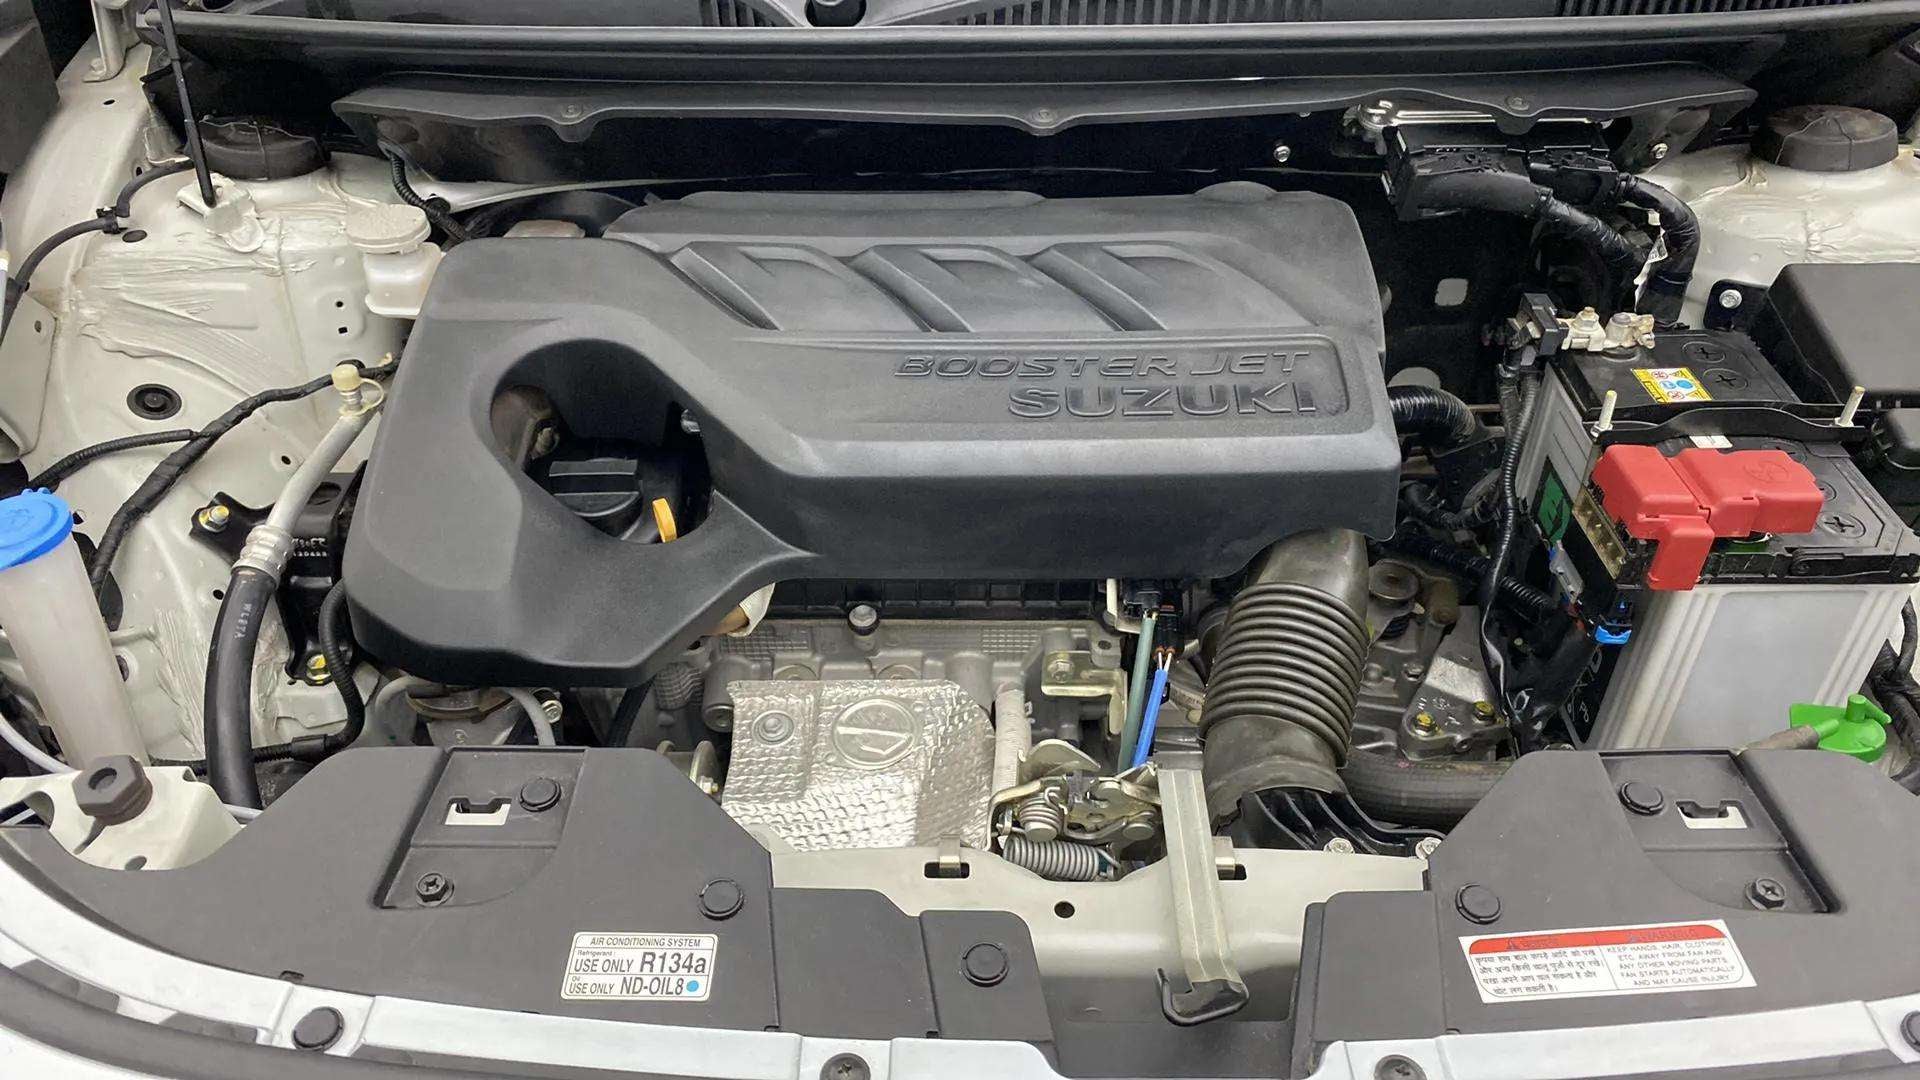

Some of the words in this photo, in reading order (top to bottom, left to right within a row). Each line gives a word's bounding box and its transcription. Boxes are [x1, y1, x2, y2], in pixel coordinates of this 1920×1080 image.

[894, 354, 1177, 378] BOOSTER
[1189, 351, 1310, 375] JET
[1008, 382, 1317, 417] SUZUKI
[590, 937, 605, 946] AIR
[606, 937, 665, 947] CONDITIONING
[667, 938, 701, 947] SYSTEM
[1662, 951, 1686, 959] FROM
[574, 959, 599, 972] USE
[601, 959, 634, 973] ONLY
[639, 951, 707, 974] R134a
[1637, 961, 1665, 969] OTHER
[1668, 959, 1699, 967] MOVING
[1702, 957, 1728, 965] PARTS
[1639, 969, 1670, 977] STARTS
[1672, 965, 1735, 975] AUTOMATICALLY
[569, 982, 588, 994] USE
[590, 983, 615, 994] ONLY
[620, 977, 685, 995] ND-OIL8
[1633, 979, 1650, 987] AND
[1671, 976, 1699, 984] CAUSE
